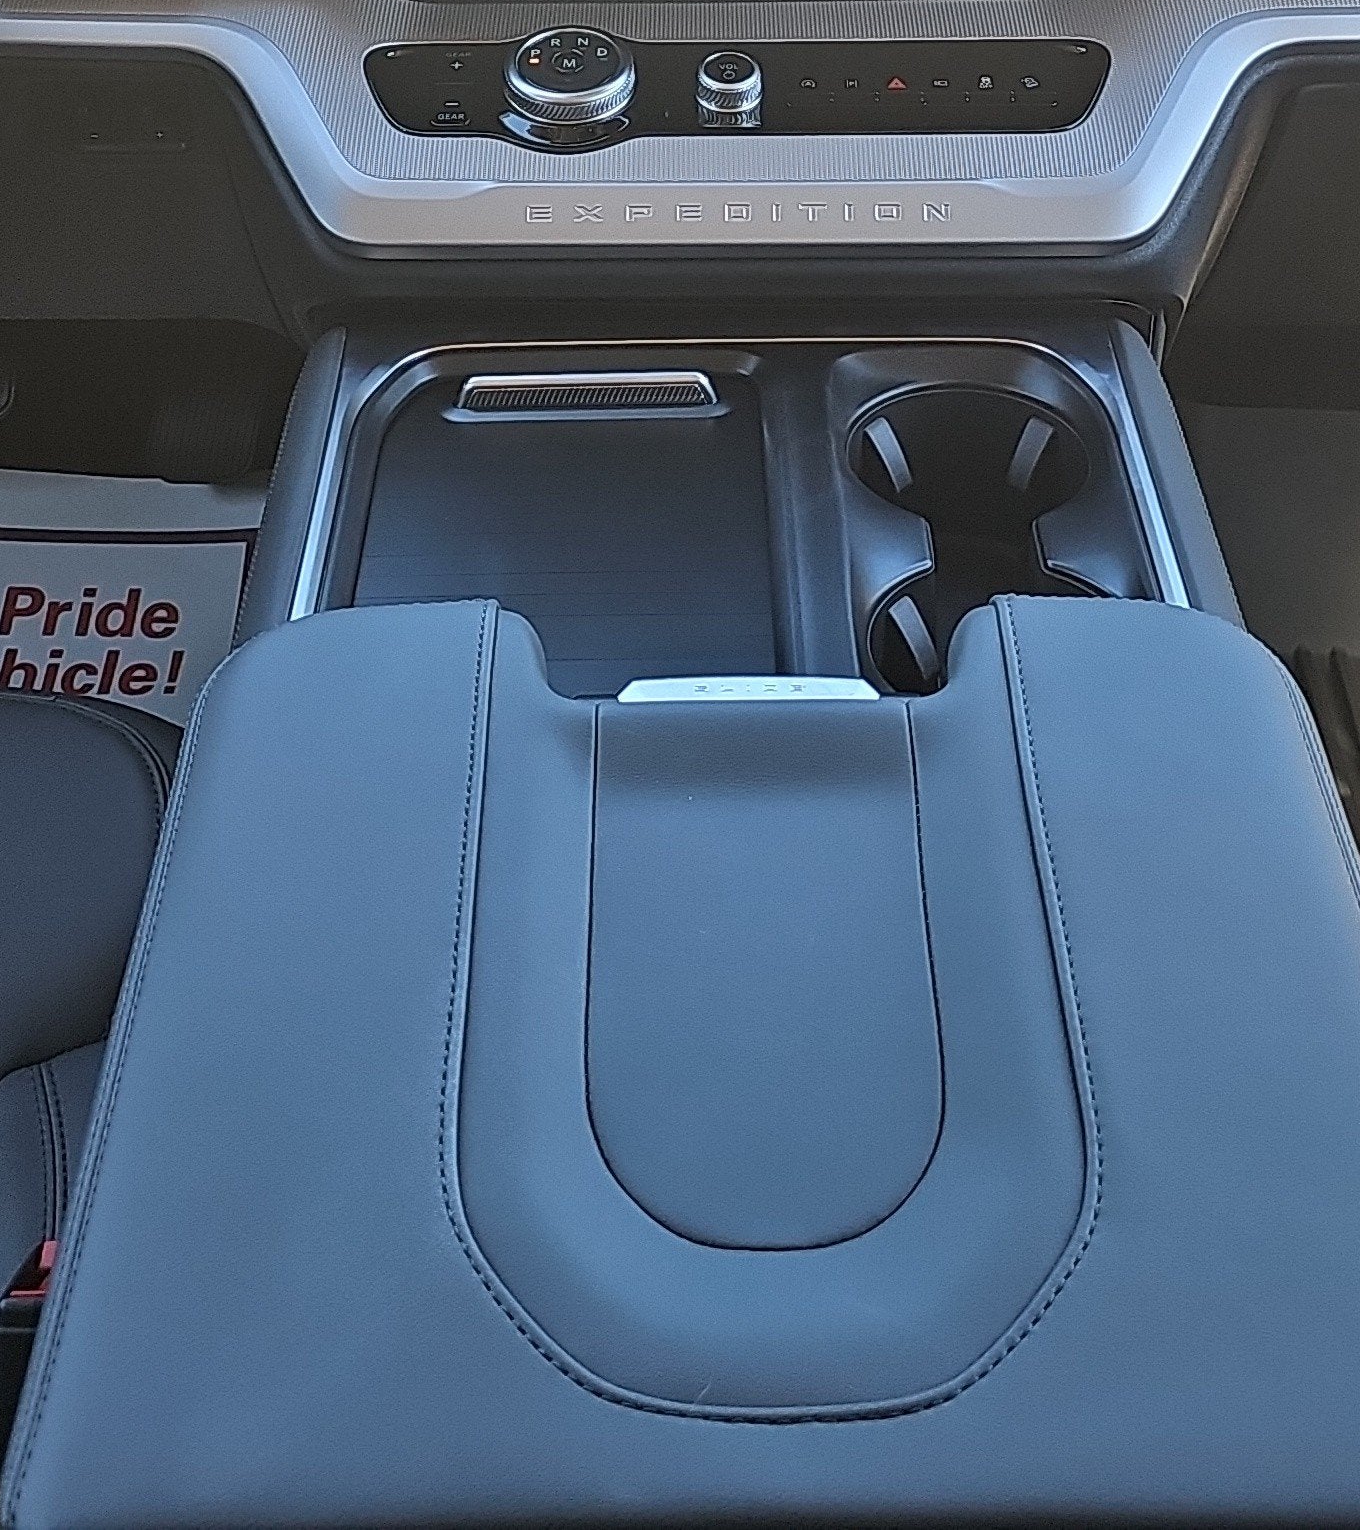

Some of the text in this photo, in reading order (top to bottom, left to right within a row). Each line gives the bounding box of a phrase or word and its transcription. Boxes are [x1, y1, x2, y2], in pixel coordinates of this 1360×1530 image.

[550, 37, 589, 47] R N
[530, 47, 608, 58] P D
[563, 58, 576, 68] M
[437, 112, 465, 120] GEAR
[525, 202, 952, 224] EXPEDITION
